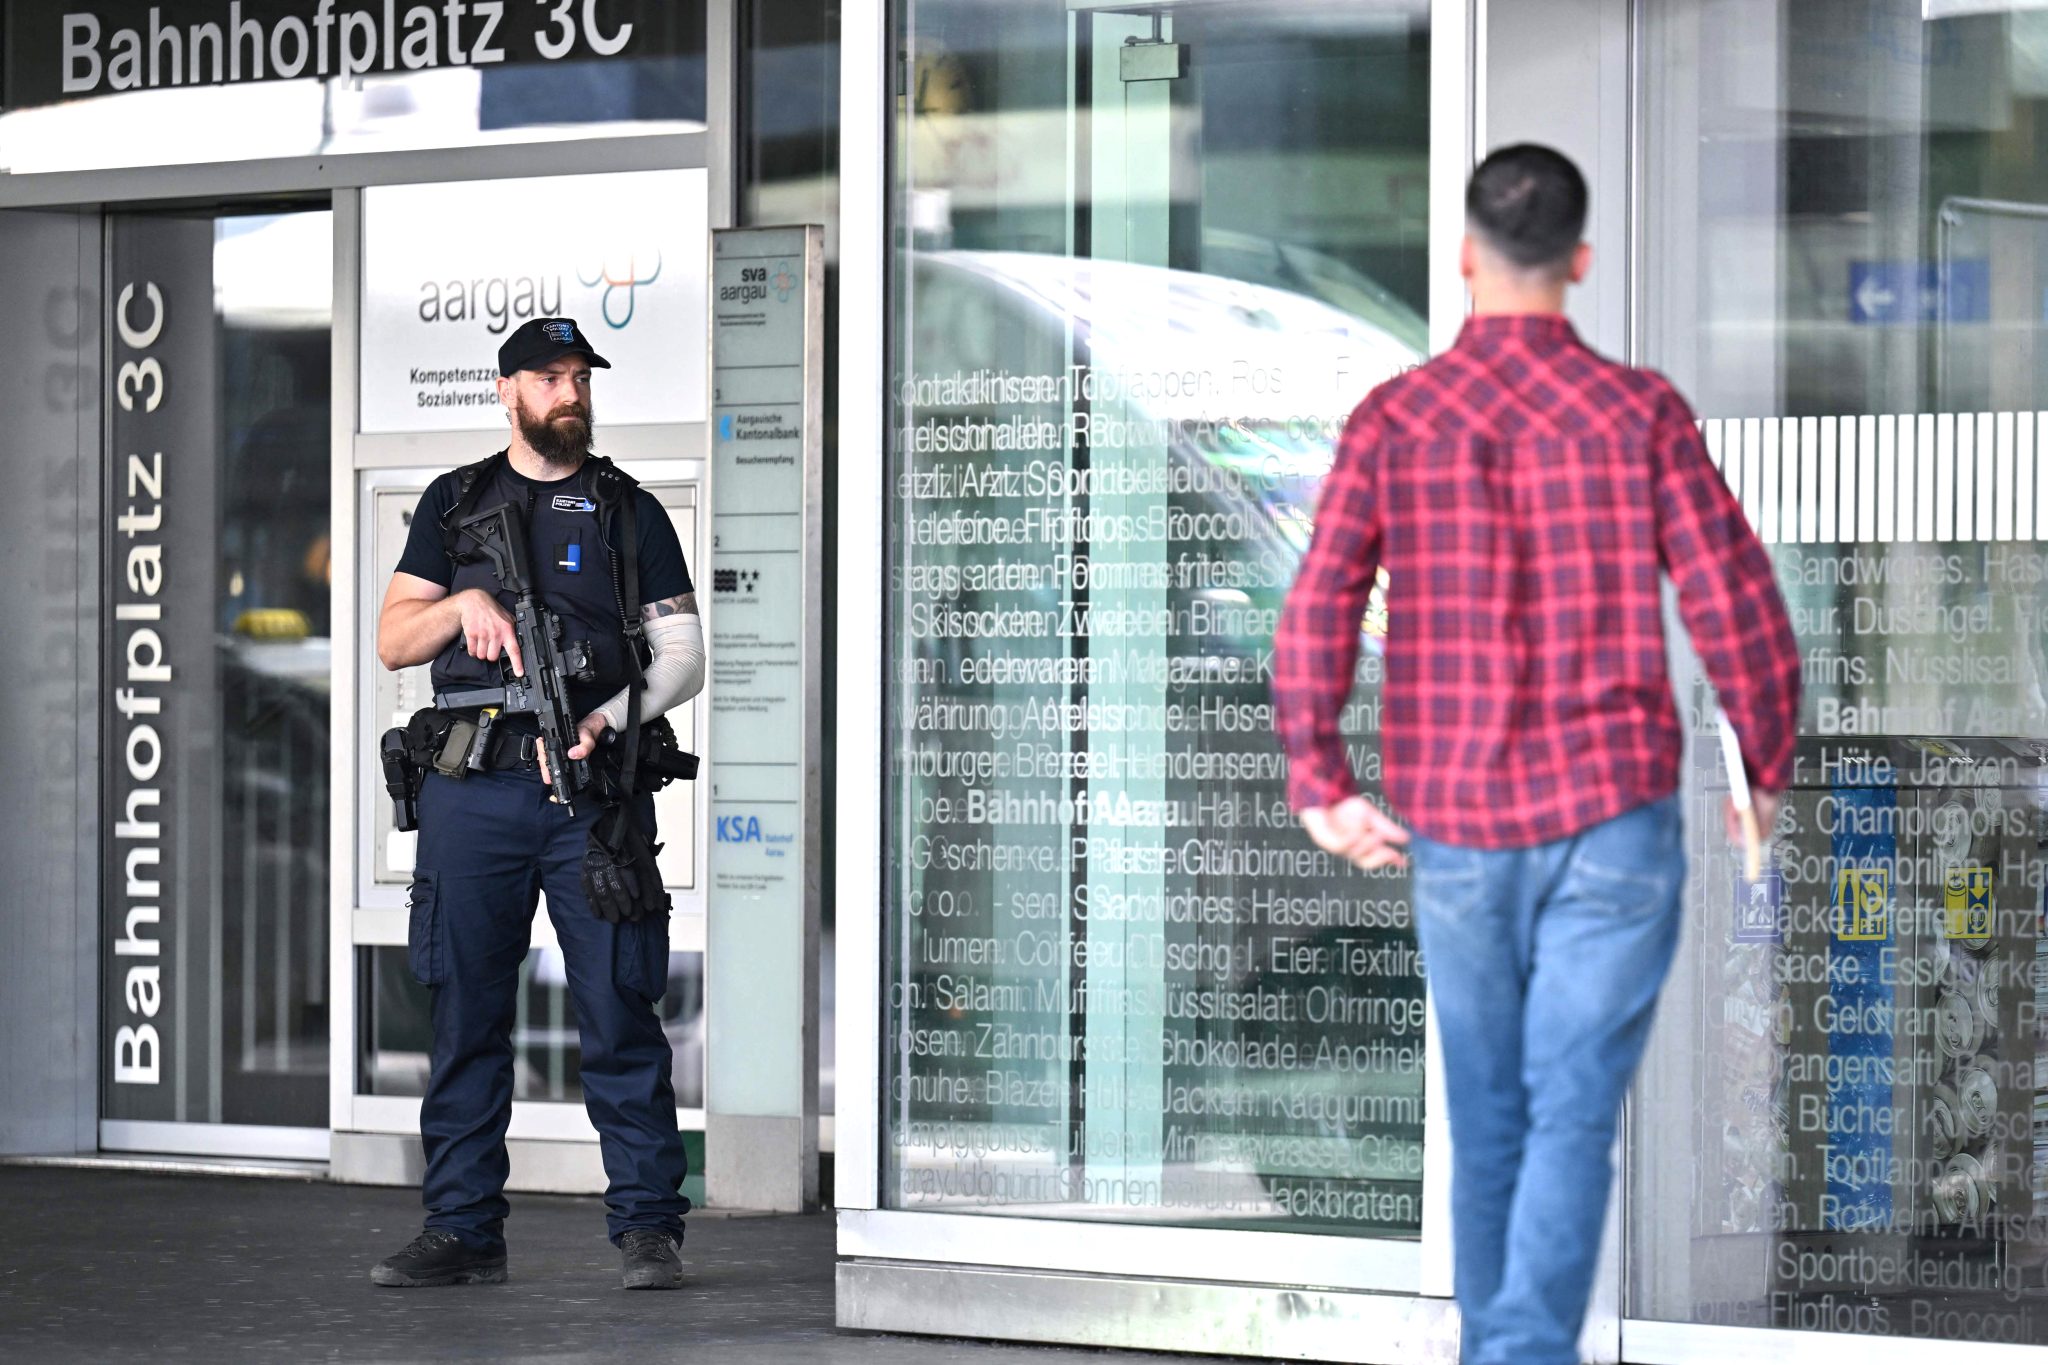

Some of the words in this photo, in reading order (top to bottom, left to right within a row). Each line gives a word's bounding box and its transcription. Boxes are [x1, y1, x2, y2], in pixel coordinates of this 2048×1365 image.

[62, 0, 506, 93] Bahnhofplatz
[534, 0, 634, 60] 3C
[742, 267, 767, 282] sva
[418, 274, 563, 334] aargau
[720, 285, 767, 305] aargau
[116, 281, 164, 413] 3C
[410, 366, 499, 386] Kompetenzze
[417, 389, 501, 409] Sozialversic
[736, 427, 800, 440] Kantonalbank
[114, 452, 172, 1085] Bahnhofplatz
[716, 815, 761, 842] KSA
